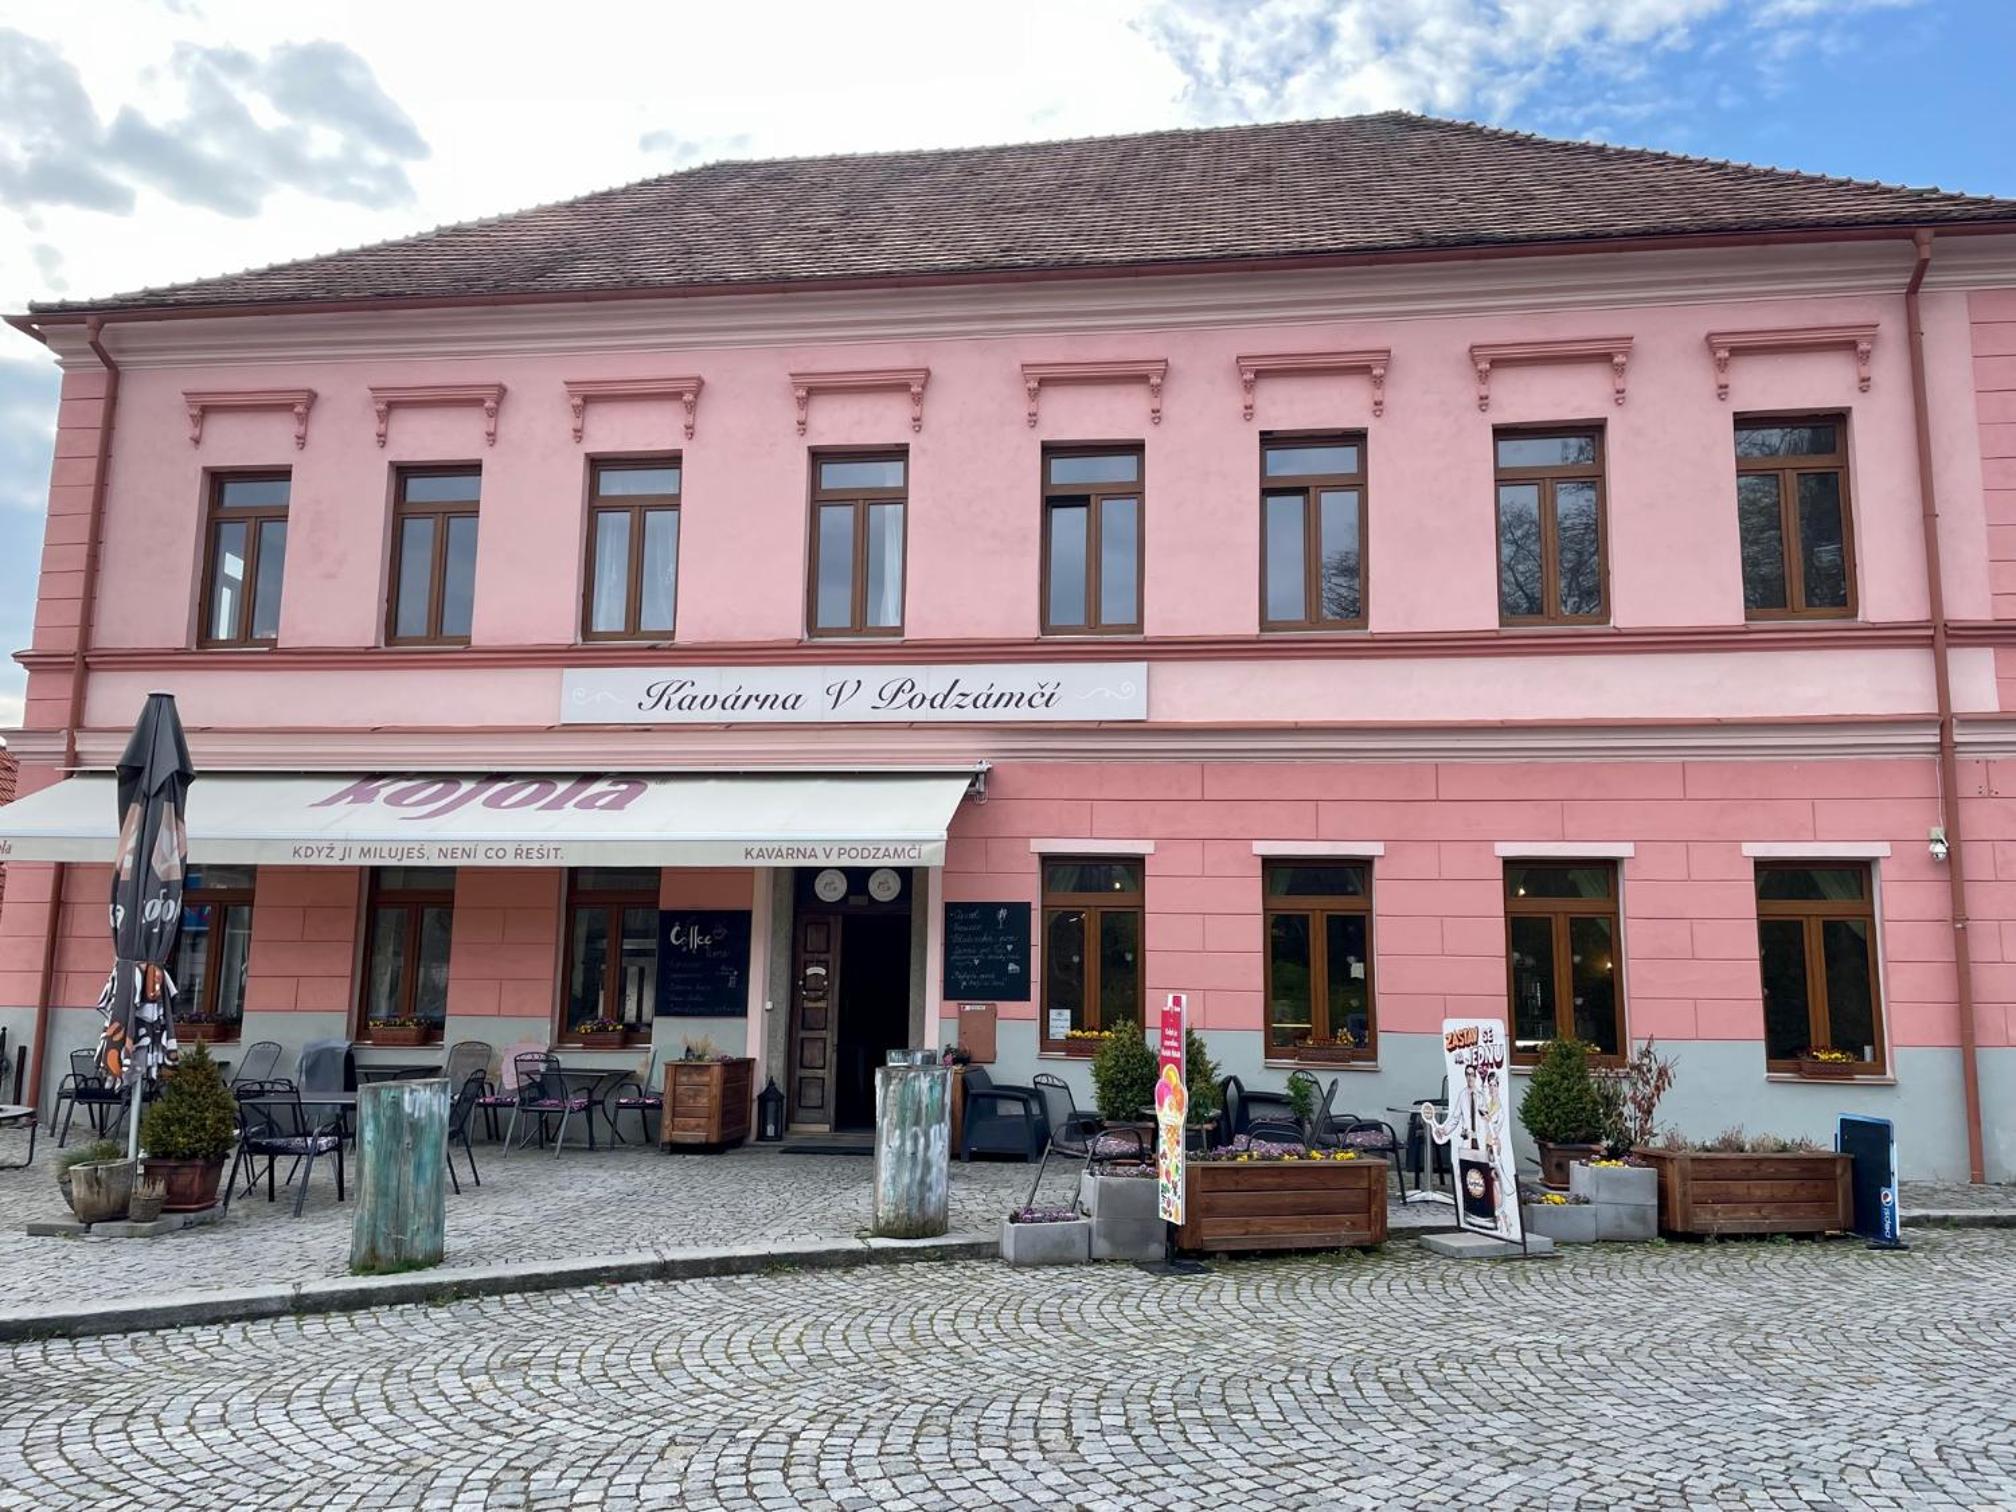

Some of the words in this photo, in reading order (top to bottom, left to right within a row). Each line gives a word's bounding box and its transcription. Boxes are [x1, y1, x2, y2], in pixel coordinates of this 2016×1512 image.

[637, 679, 807, 711] Kavárna
[825, 679, 862, 710] V
[871, 677, 1062, 710] Podzámčí
[292, 842, 336, 859] KDYŽ
[338, 846, 353, 861] JI
[358, 843, 430, 861] MILUJEŠ,
[437, 843, 479, 860] NENÍ
[484, 847, 507, 860] CO
[514, 843, 564, 860] ŘEŠIT.
[822, 847, 833, 860] V
[1445, 1026, 1479, 1053] ZASTAV
[1482, 1027, 1494, 1044] SE
